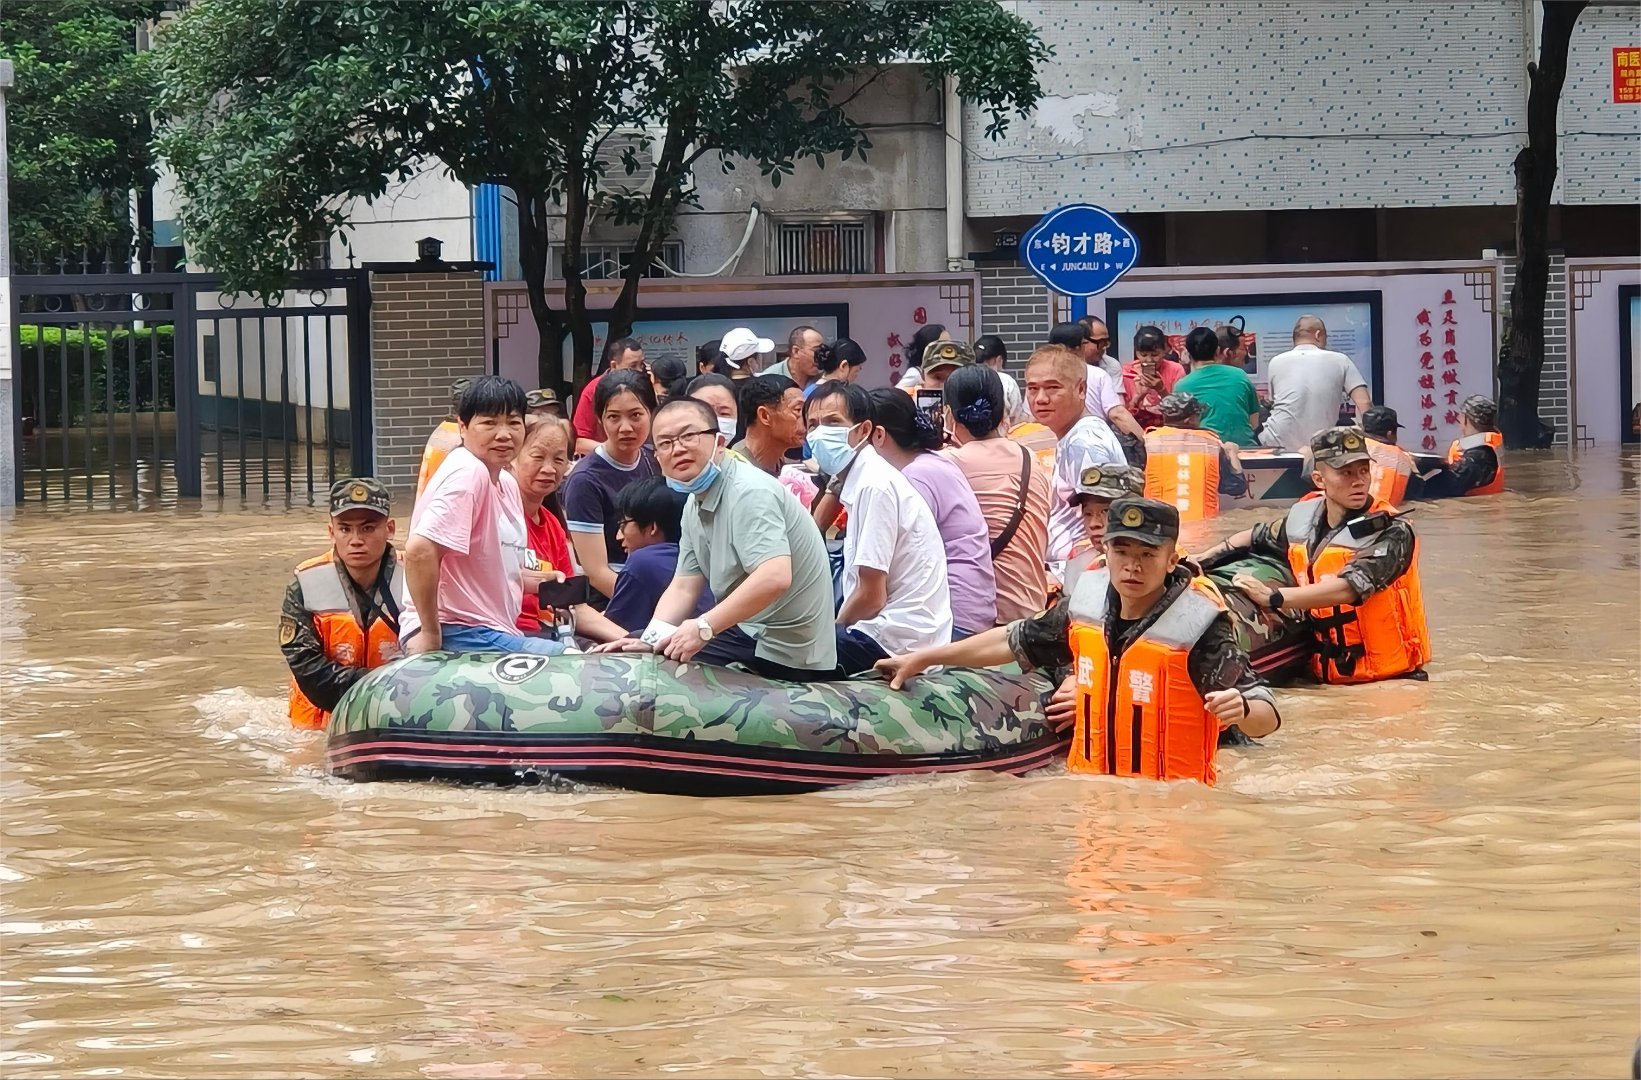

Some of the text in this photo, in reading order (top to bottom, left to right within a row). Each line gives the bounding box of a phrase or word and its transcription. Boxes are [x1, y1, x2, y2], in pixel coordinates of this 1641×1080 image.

[1034, 232, 1131, 255] 东 钧才路 西
[1040, 263, 1046, 271] E
[1115, 262, 1124, 270] W
[1129, 669, 1154, 703] 警
